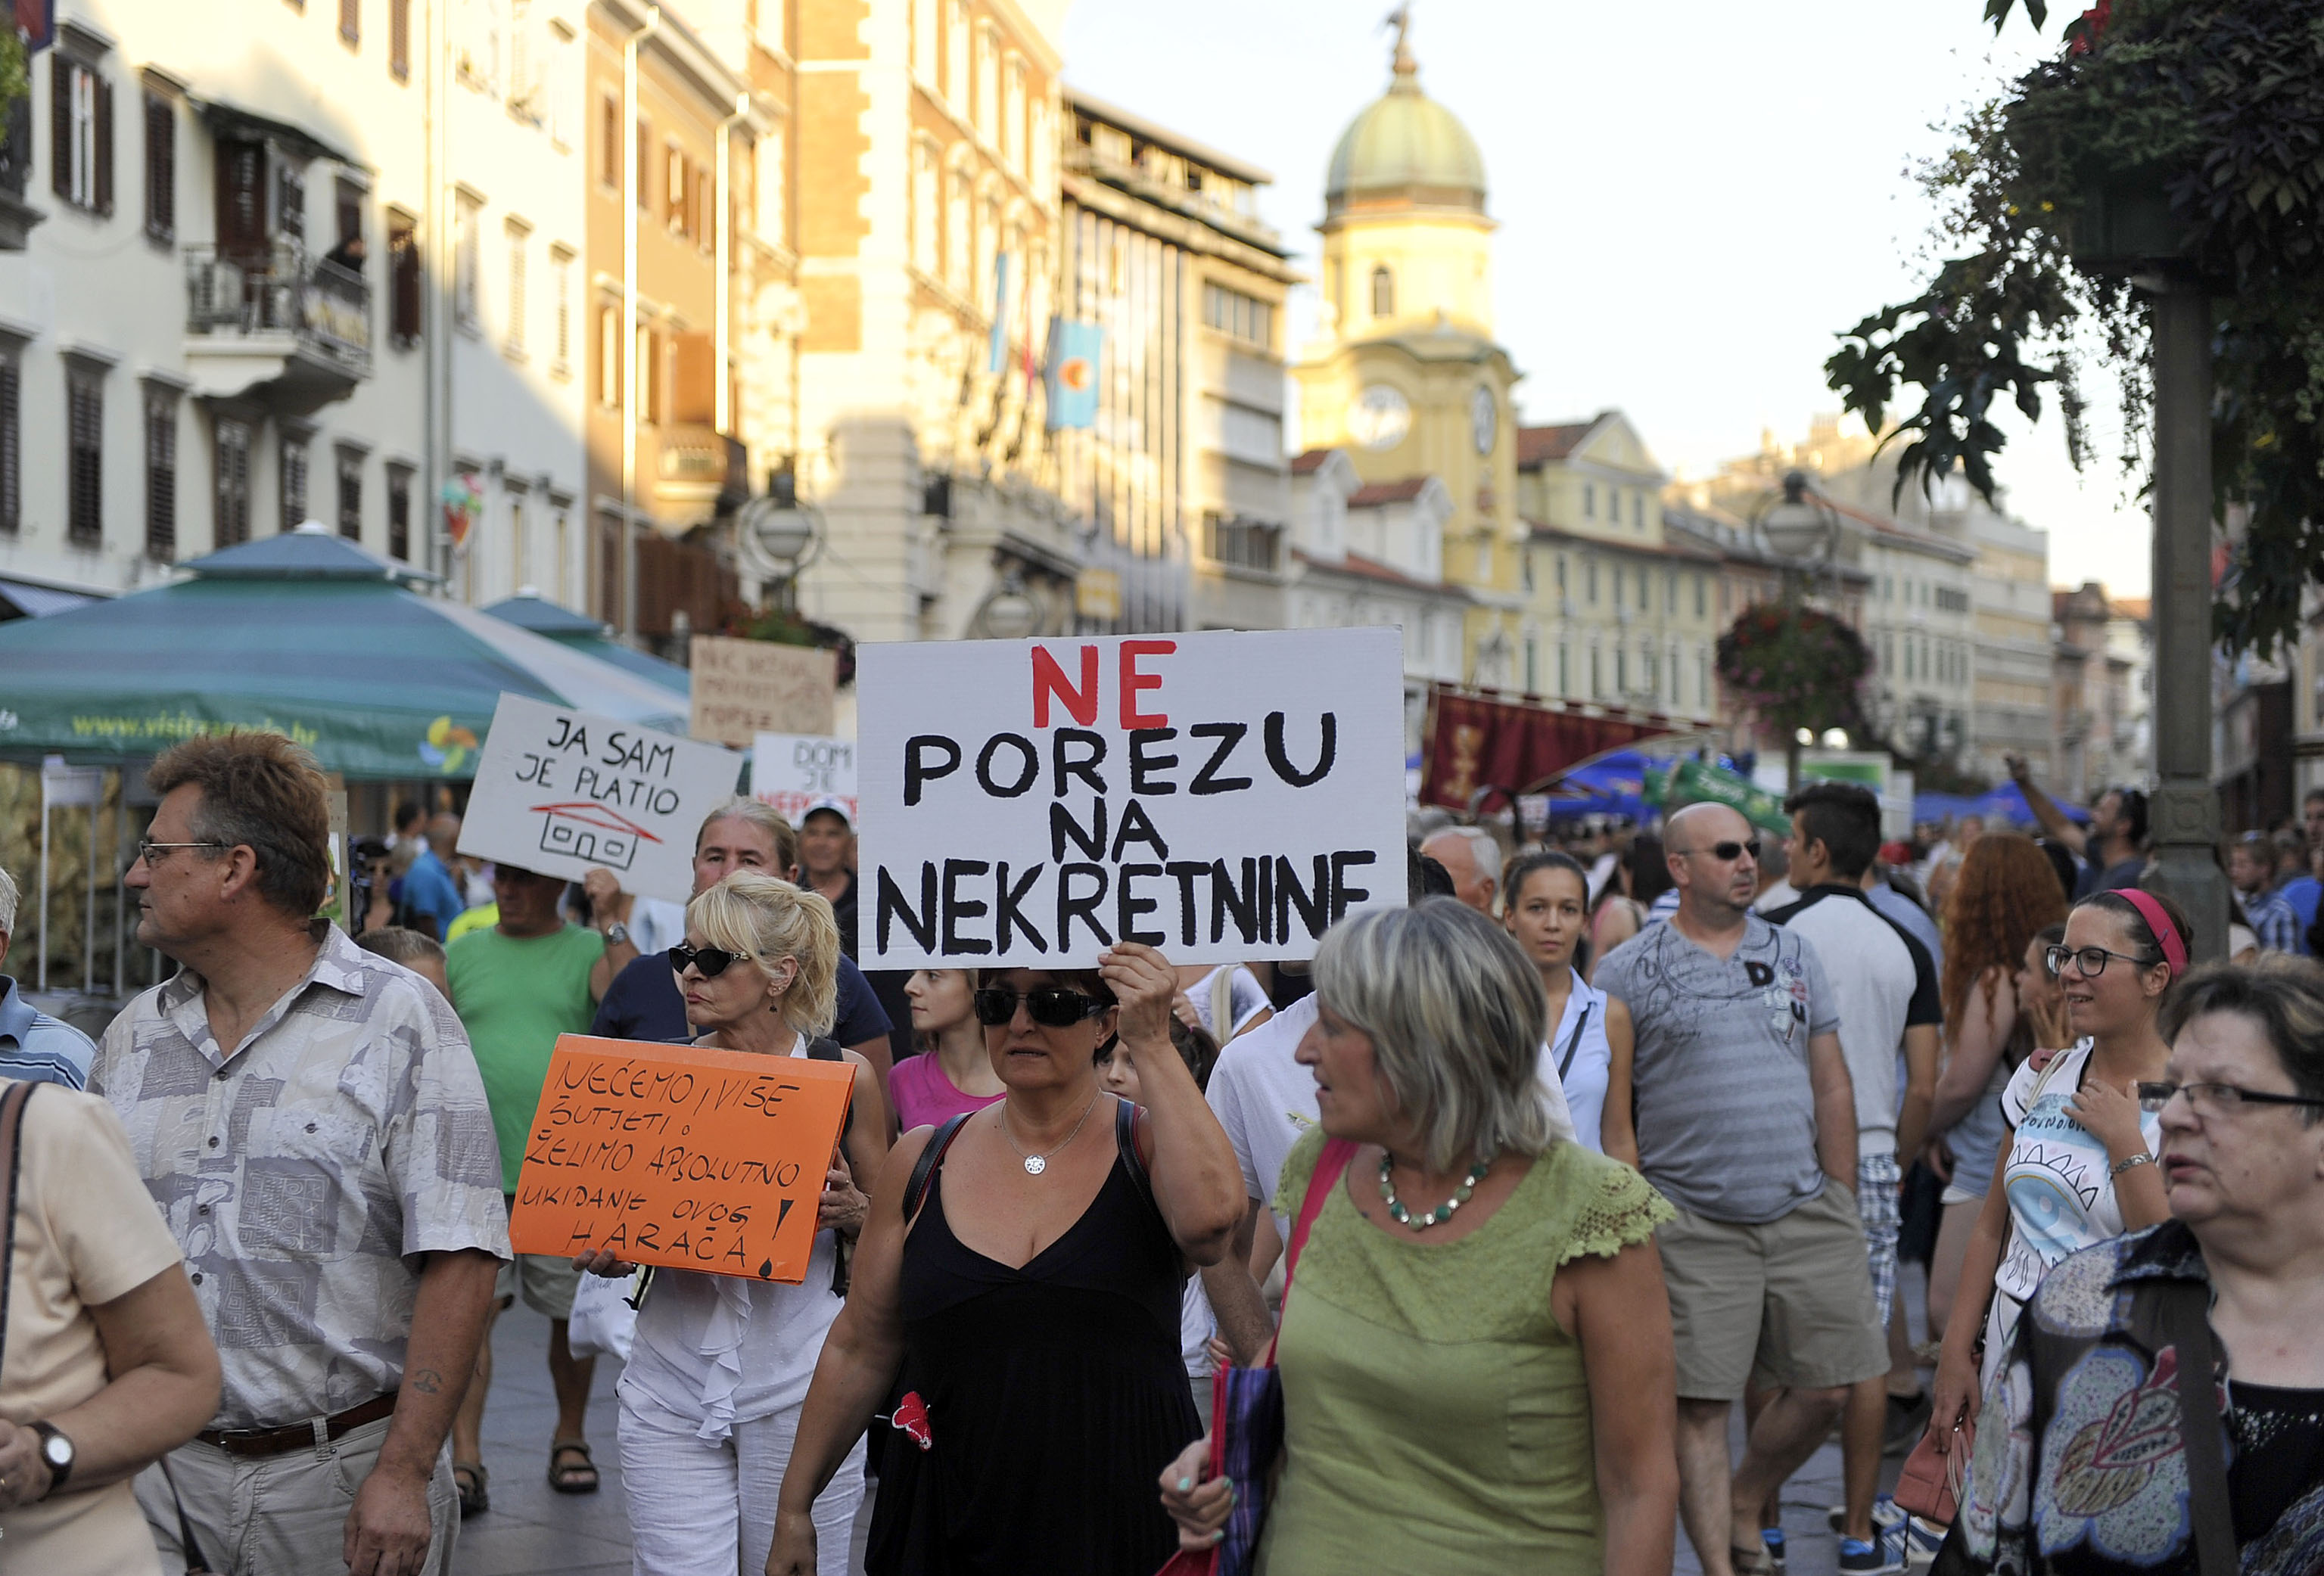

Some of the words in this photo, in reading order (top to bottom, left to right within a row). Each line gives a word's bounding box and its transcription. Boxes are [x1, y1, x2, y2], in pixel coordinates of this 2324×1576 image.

[1031, 639, 1178, 730] NE
[547, 717, 588, 757] JA
[602, 732, 674, 778] SAM
[793, 740, 853, 772] DOM
[904, 711, 1336, 807] POREZU
[515, 754, 556, 788] JE
[575, 766, 680, 815] PLATIO
[1050, 796, 1169, 864] NA
[524, 1130, 634, 1172] ŽELIMO
[645, 1144, 801, 1188] APSOLUTNO
[521, 1185, 647, 1220] UKIDANJE
[672, 1198, 752, 1233] OVOG
